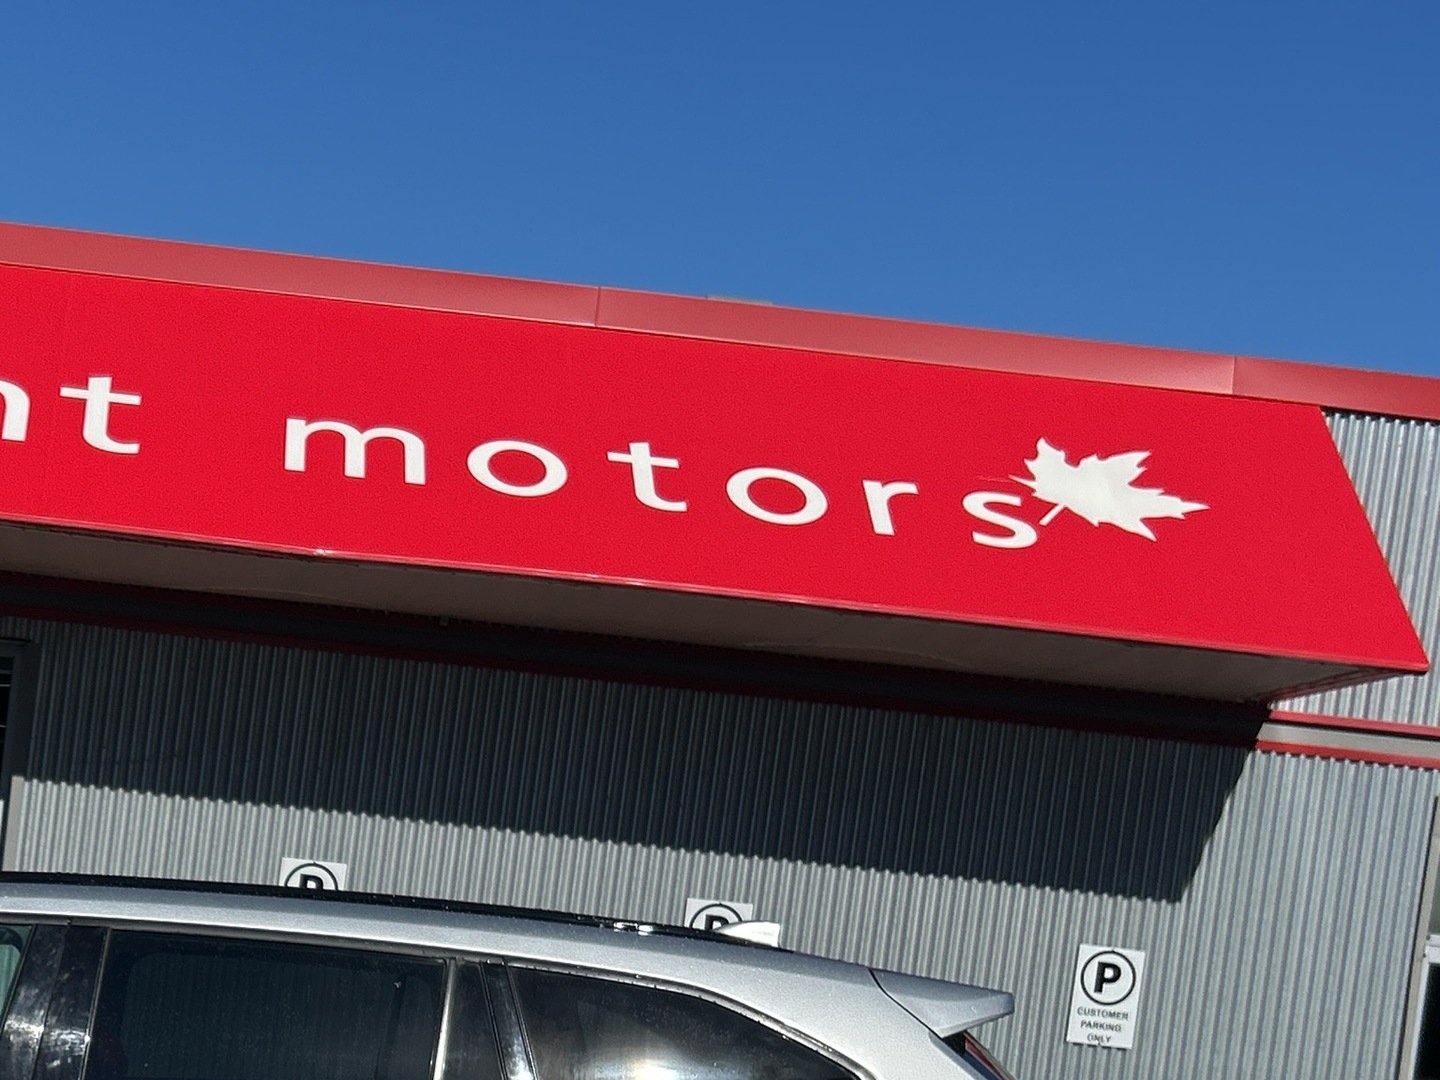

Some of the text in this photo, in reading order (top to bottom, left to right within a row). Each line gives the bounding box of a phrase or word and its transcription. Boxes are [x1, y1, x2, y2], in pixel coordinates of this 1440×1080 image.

[284, 417, 1038, 549] motors
[1094, 961, 1121, 993] P
[1077, 1006, 1129, 1020] CUSTOMER
[1080, 1020, 1122, 1032] PARKING
[1087, 1033, 1112, 1043] ONLY
